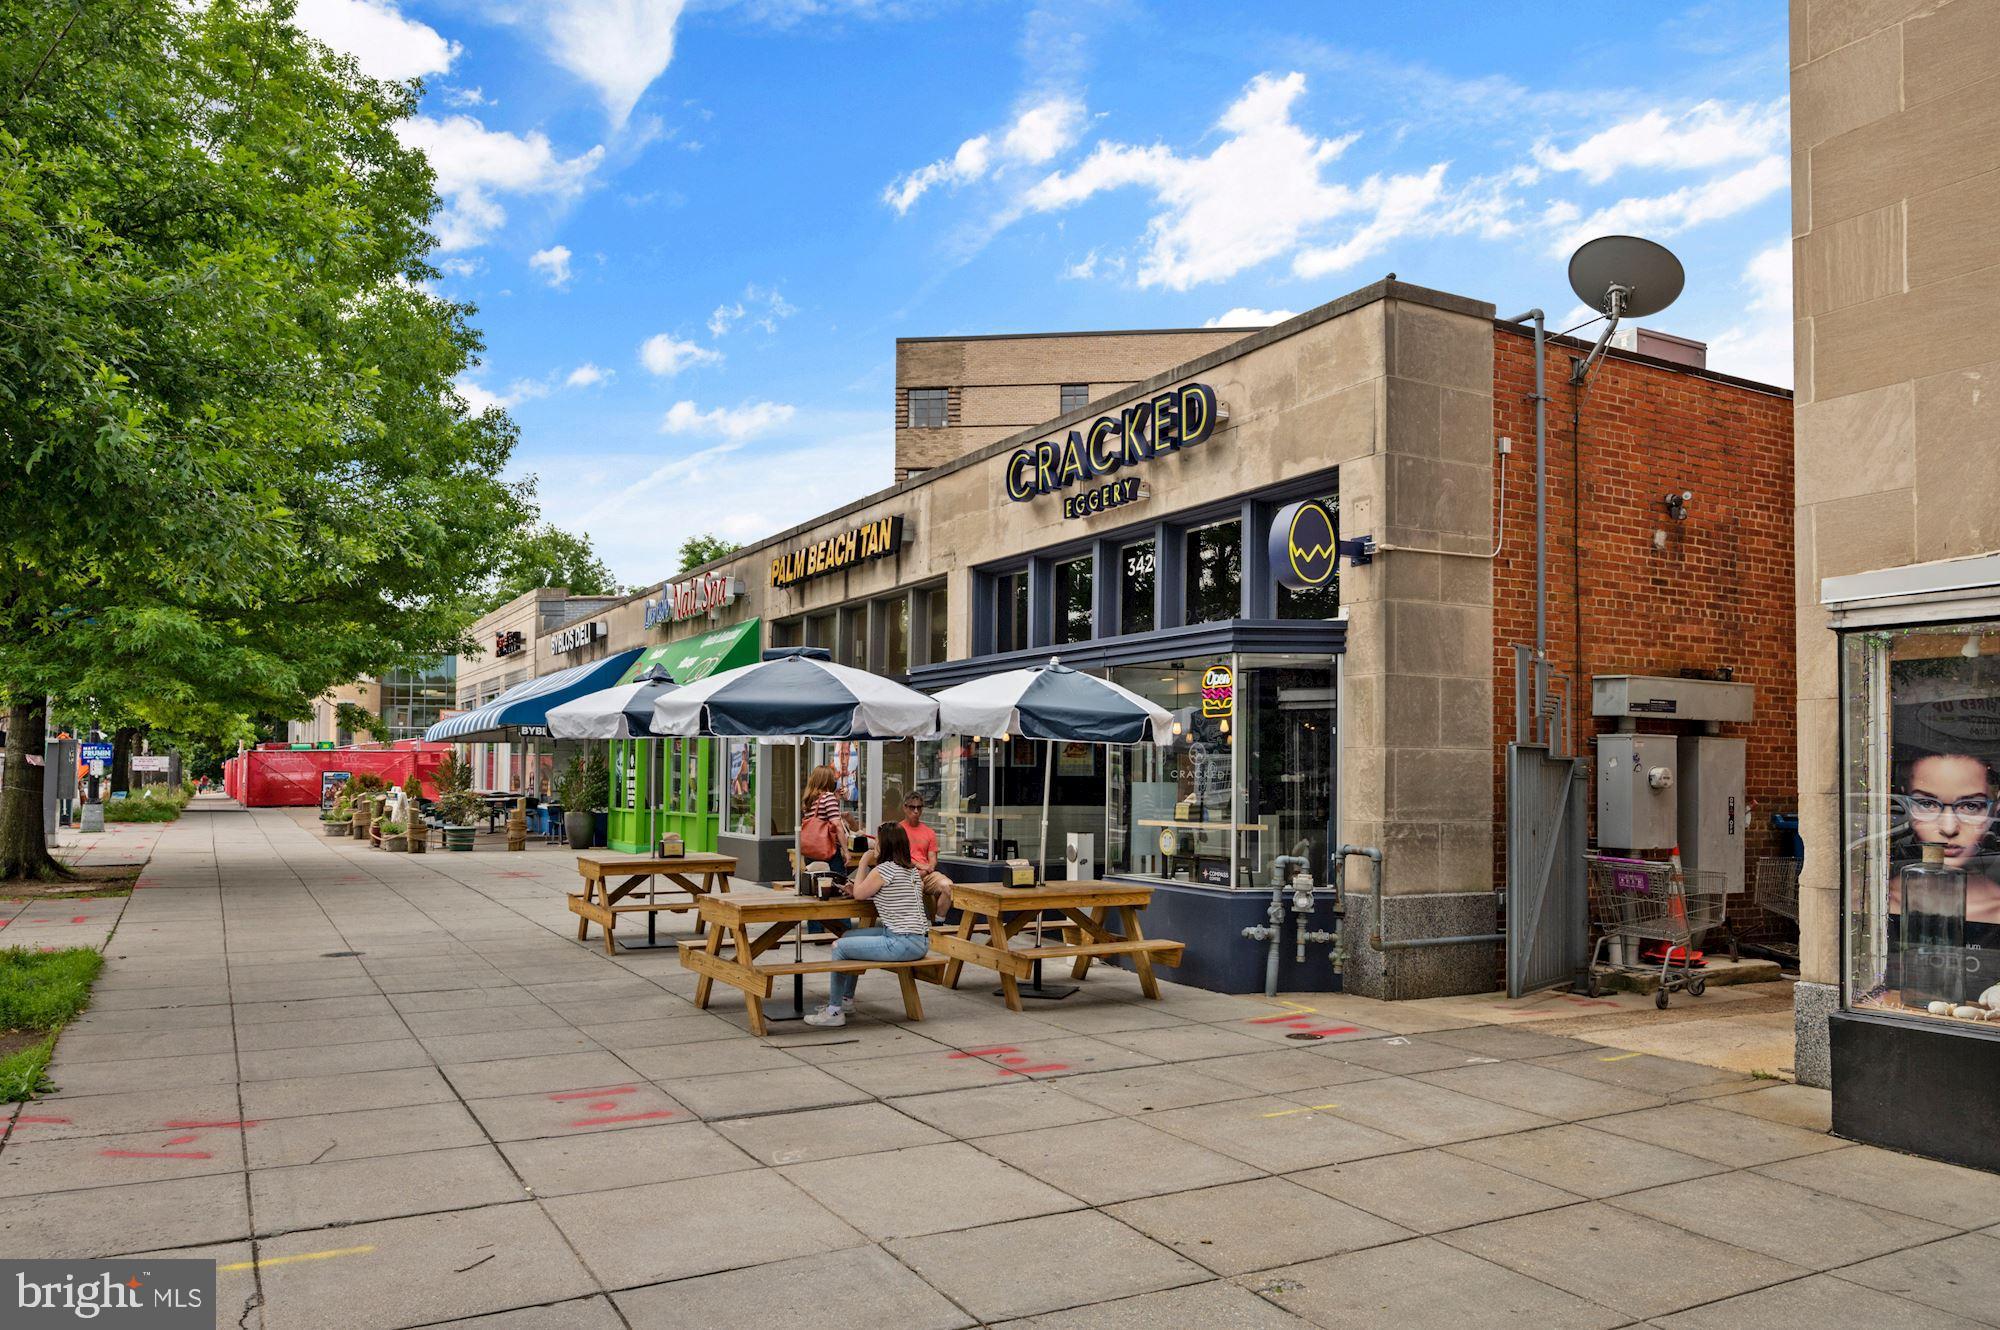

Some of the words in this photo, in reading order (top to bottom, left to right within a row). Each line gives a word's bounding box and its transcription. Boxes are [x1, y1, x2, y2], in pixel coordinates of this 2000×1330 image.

[1006, 382, 1217, 502] CRACKED
[1064, 478, 1141, 519] EGGERY
[771, 548, 806, 587] PALM
[807, 529, 858, 575] BEACH
[860, 516, 893, 558] TAN
[1127, 554, 1157, 577] 342
[673, 577, 698, 622] Nail
[701, 571, 727, 620] Spa
[550, 628, 575, 656] BYBLOS
[575, 622, 591, 648] DELI
[1205, 671, 1231, 688] Open
[1170, 769, 1225, 780] CRACKED
[1208, 870, 1229, 879] COMPASS
